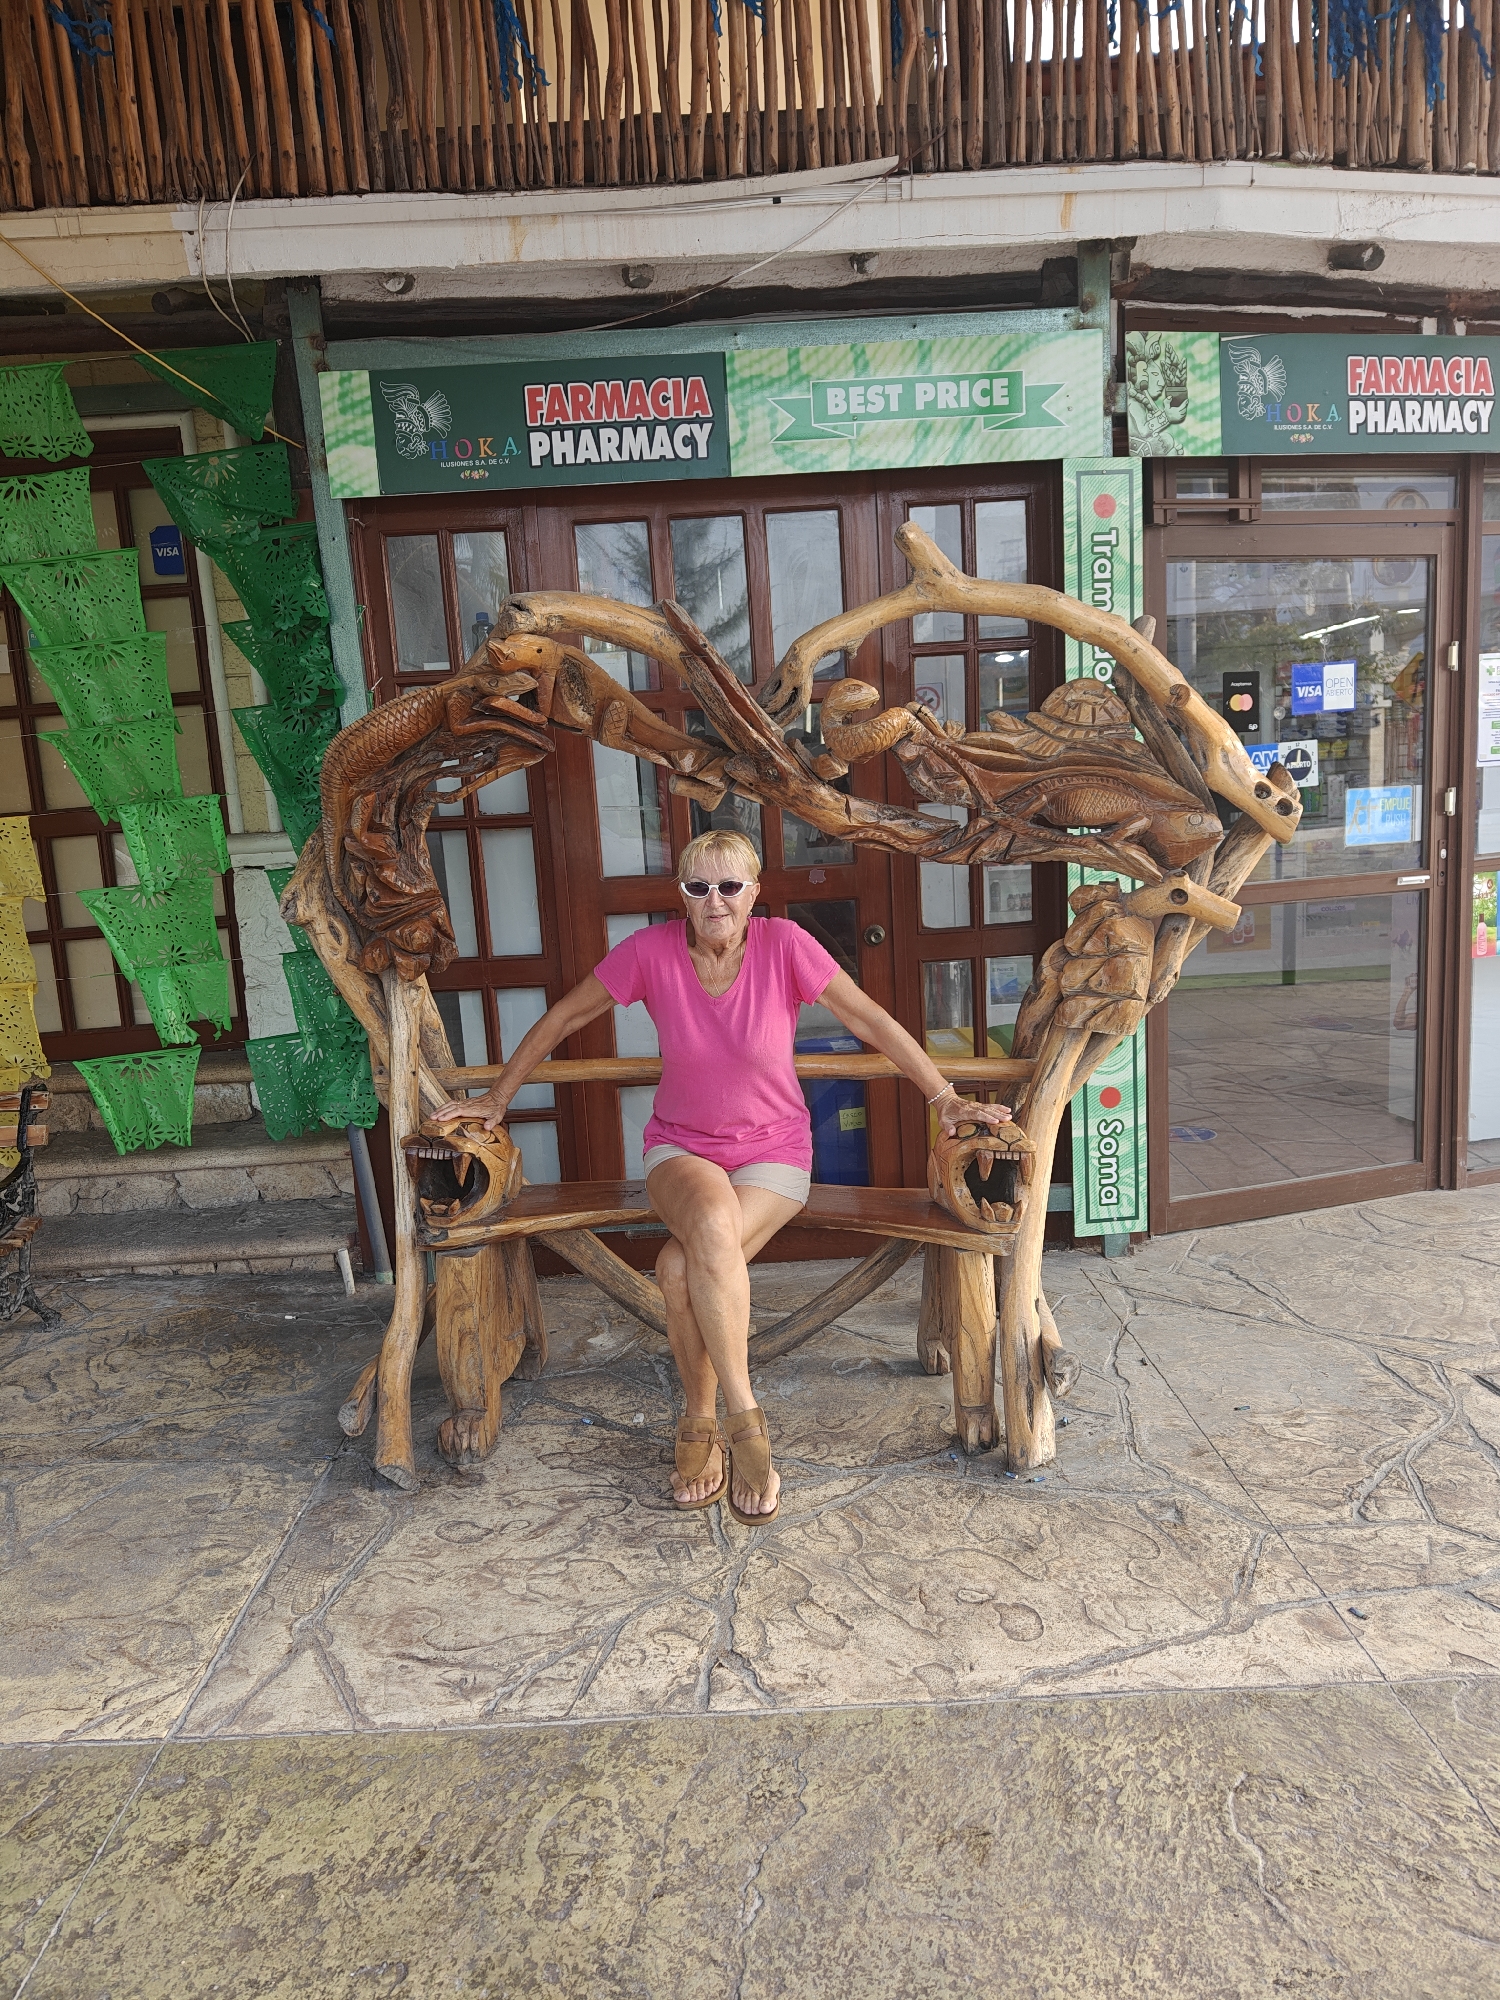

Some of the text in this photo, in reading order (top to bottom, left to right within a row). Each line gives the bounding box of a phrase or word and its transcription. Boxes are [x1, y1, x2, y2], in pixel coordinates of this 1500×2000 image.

[1347, 355, 1495, 397] FARMACIA
[524, 376, 712, 426] FARMACIA
[826, 378, 1010, 416] BEST PRICE
[1265, 403, 1342, 422] HOKA
[1349, 400, 1495, 434] PHARMACY
[428, 436, 522, 460] HOKA
[529, 423, 713, 466] PHARMACY
[440, 460, 474, 468] ILUSIONES
[154, 546, 180, 557] VISA
[1295, 685, 1323, 698] VISA
[1325, 677, 1354, 689] OPEN
[1325, 688, 1354, 697] ABIERTO
[1380, 797, 1411, 811] EMPUJE
[1385, 813, 1407, 826] PUSH
[1098, 1119, 1123, 1206] Soma
